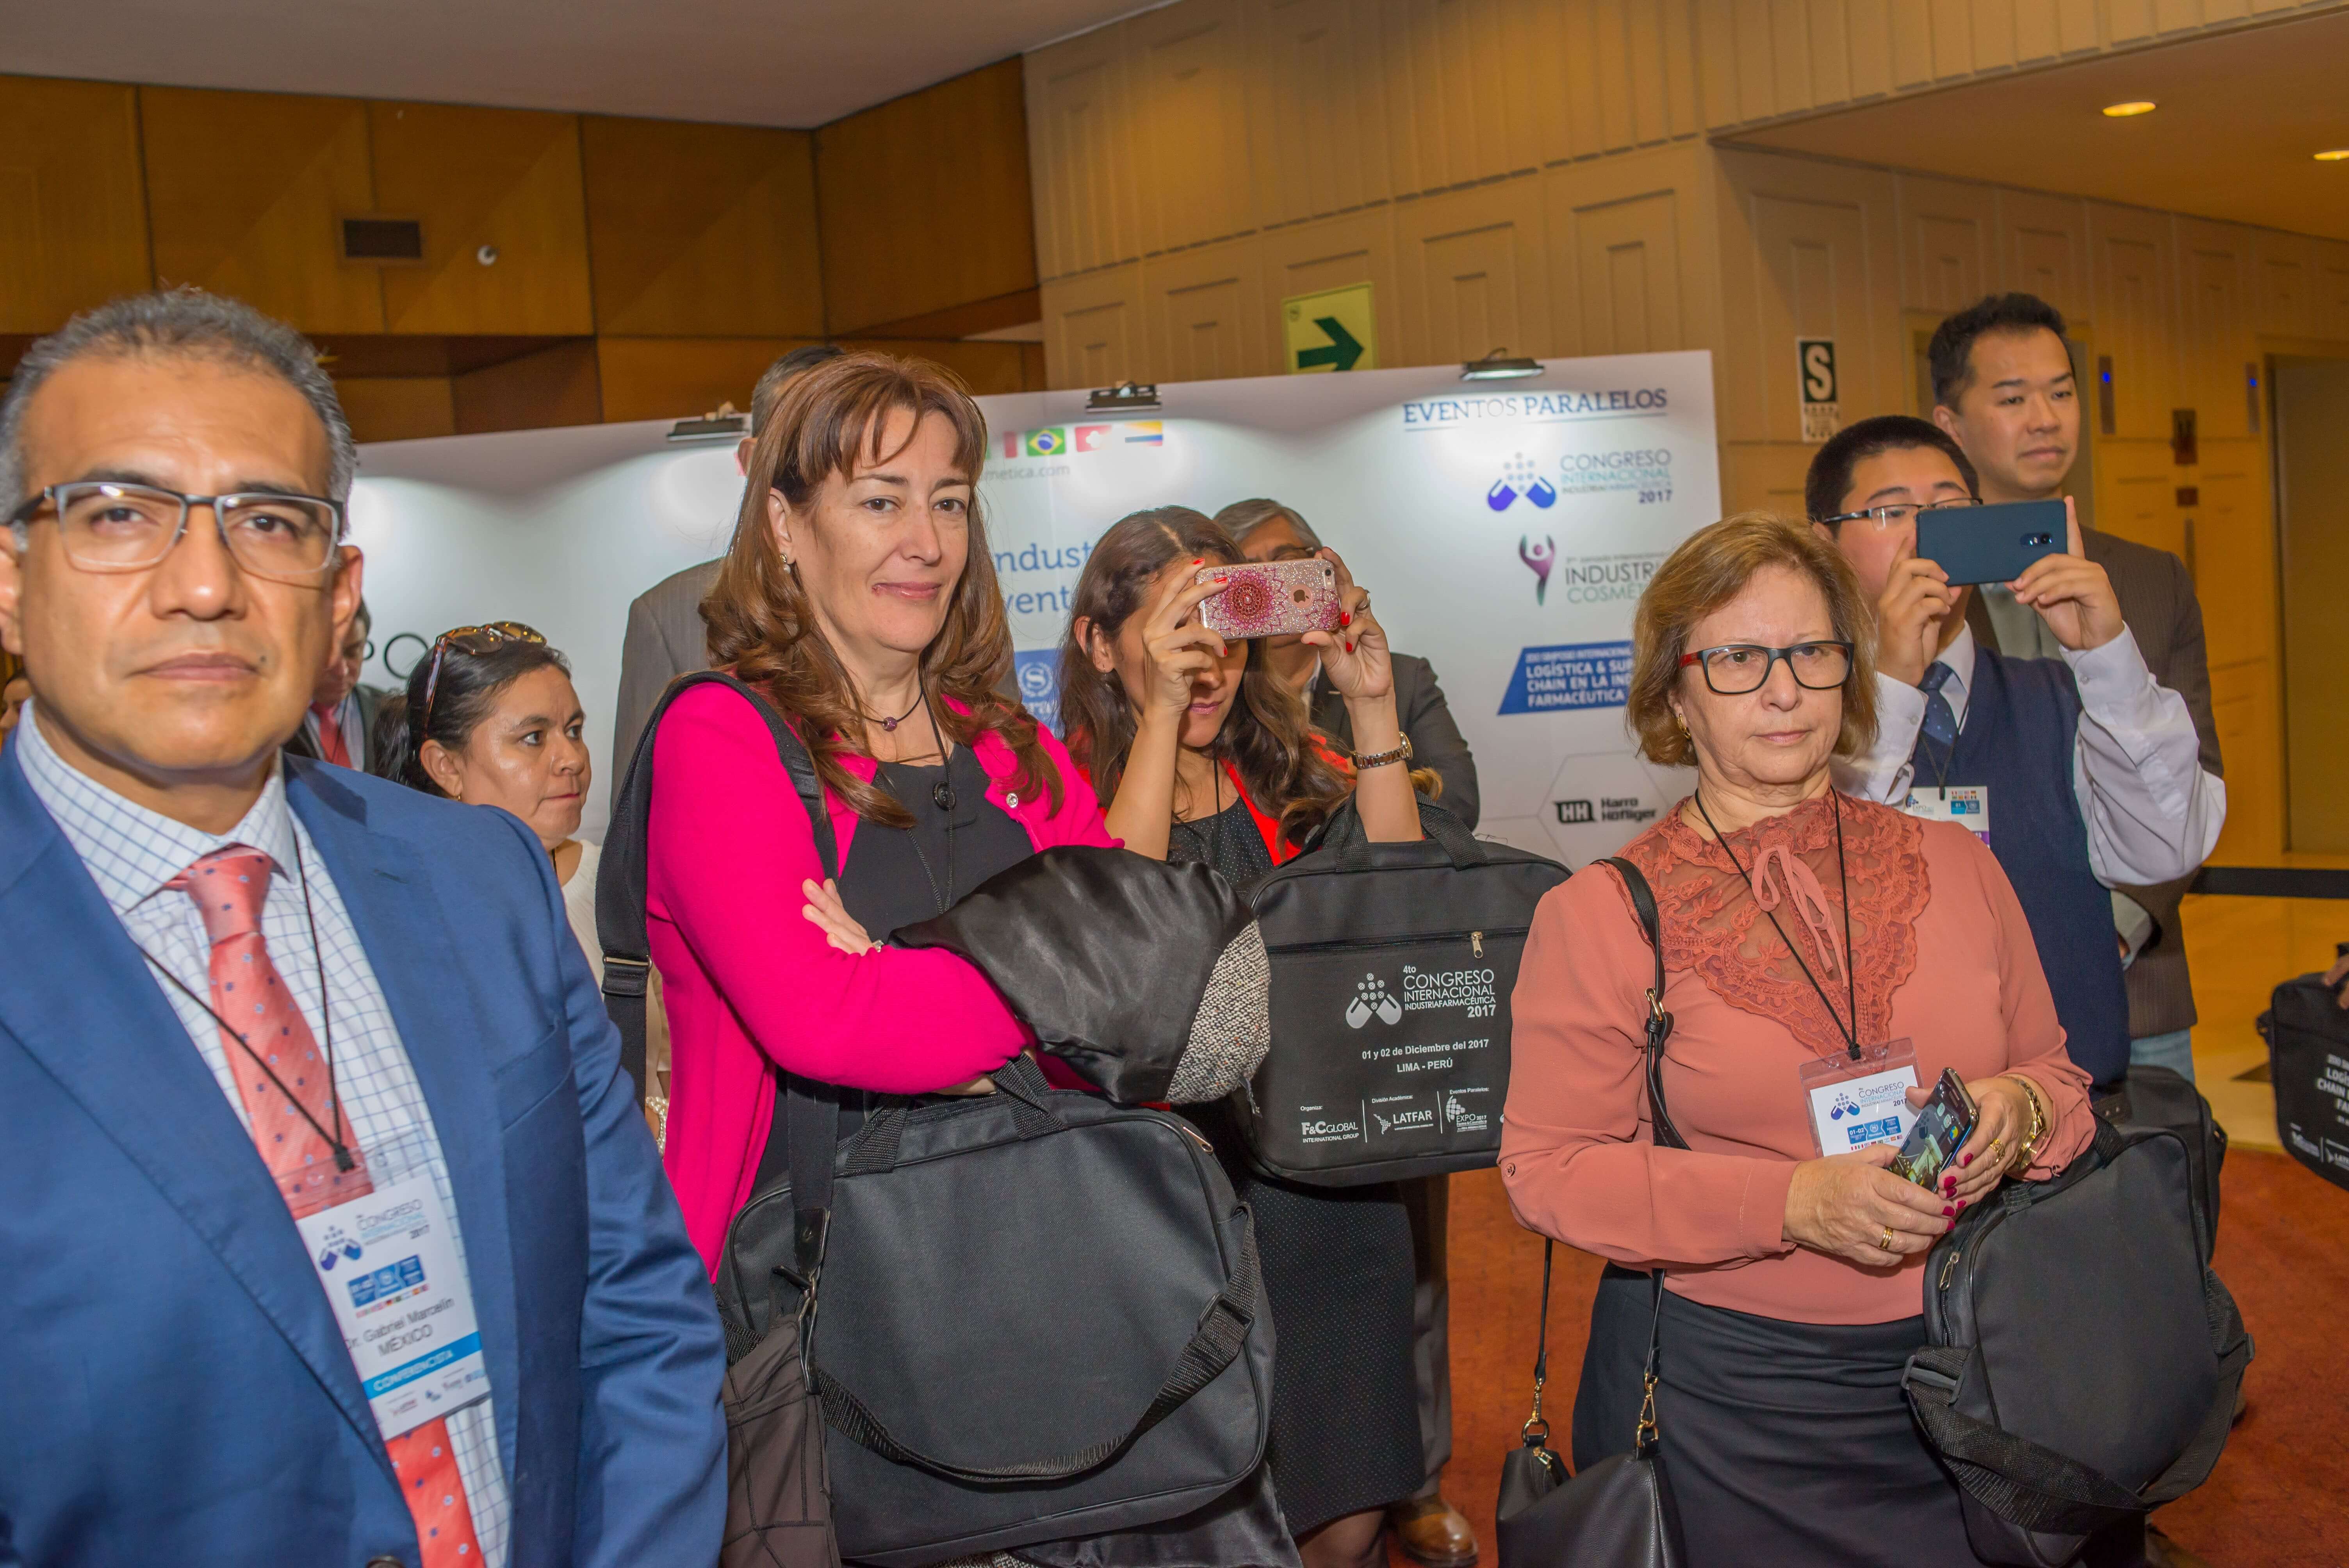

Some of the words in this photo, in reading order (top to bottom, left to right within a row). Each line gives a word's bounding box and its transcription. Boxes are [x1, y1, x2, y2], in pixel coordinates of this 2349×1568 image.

[1805, 344, 1832, 401] S
[1402, 398, 1517, 423] EVENTOS
[1524, 389, 1667, 415] PARALELOS
[1560, 448, 1672, 472] CONGRESO
[1638, 489, 1672, 504] 2017
[1596, 660, 1606, 674] &
[1527, 678, 1566, 692] CHAIN
[1570, 676, 1588, 689] EN
[1591, 675, 1608, 688] LA
[1528, 689, 1624, 706] FARMACÉUTICA
[1403, 965, 1417, 974] 4to
[1404, 969, 1494, 990] CONGRESO
[1404, 984, 1495, 1002] INTERNACIONAL
[1405, 996, 1496, 1010] INDUSTRIAFARMACÉUTICA
[1467, 1004, 1496, 1018] 2017
[1362, 1050, 1371, 1060] 01
[1373, 1051, 1379, 1060] y
[1380, 1048, 1390, 1057] 02
[1392, 1047, 1403, 1056] de
[1405, 1043, 1450, 1055] Diciembre
[1452, 1041, 1466, 1050] del
[1468, 1039, 1489, 1049] 2017
[1397, 1063, 1420, 1073] LIMA
[1427, 1057, 1453, 1070] PERÚ
[1859, 1082, 1904, 1098] CONGRESO
[1893, 1098, 1907, 1107] 2017
[1393, 1110, 1433, 1124] LATFAR
[1456, 1114, 1476, 1123] EXPO
[1303, 1135, 1342, 1143] INTERNATIONAL
[357, 1199, 424, 1231] CONGRESO
[363, 1317, 405, 1342] Gabriel
